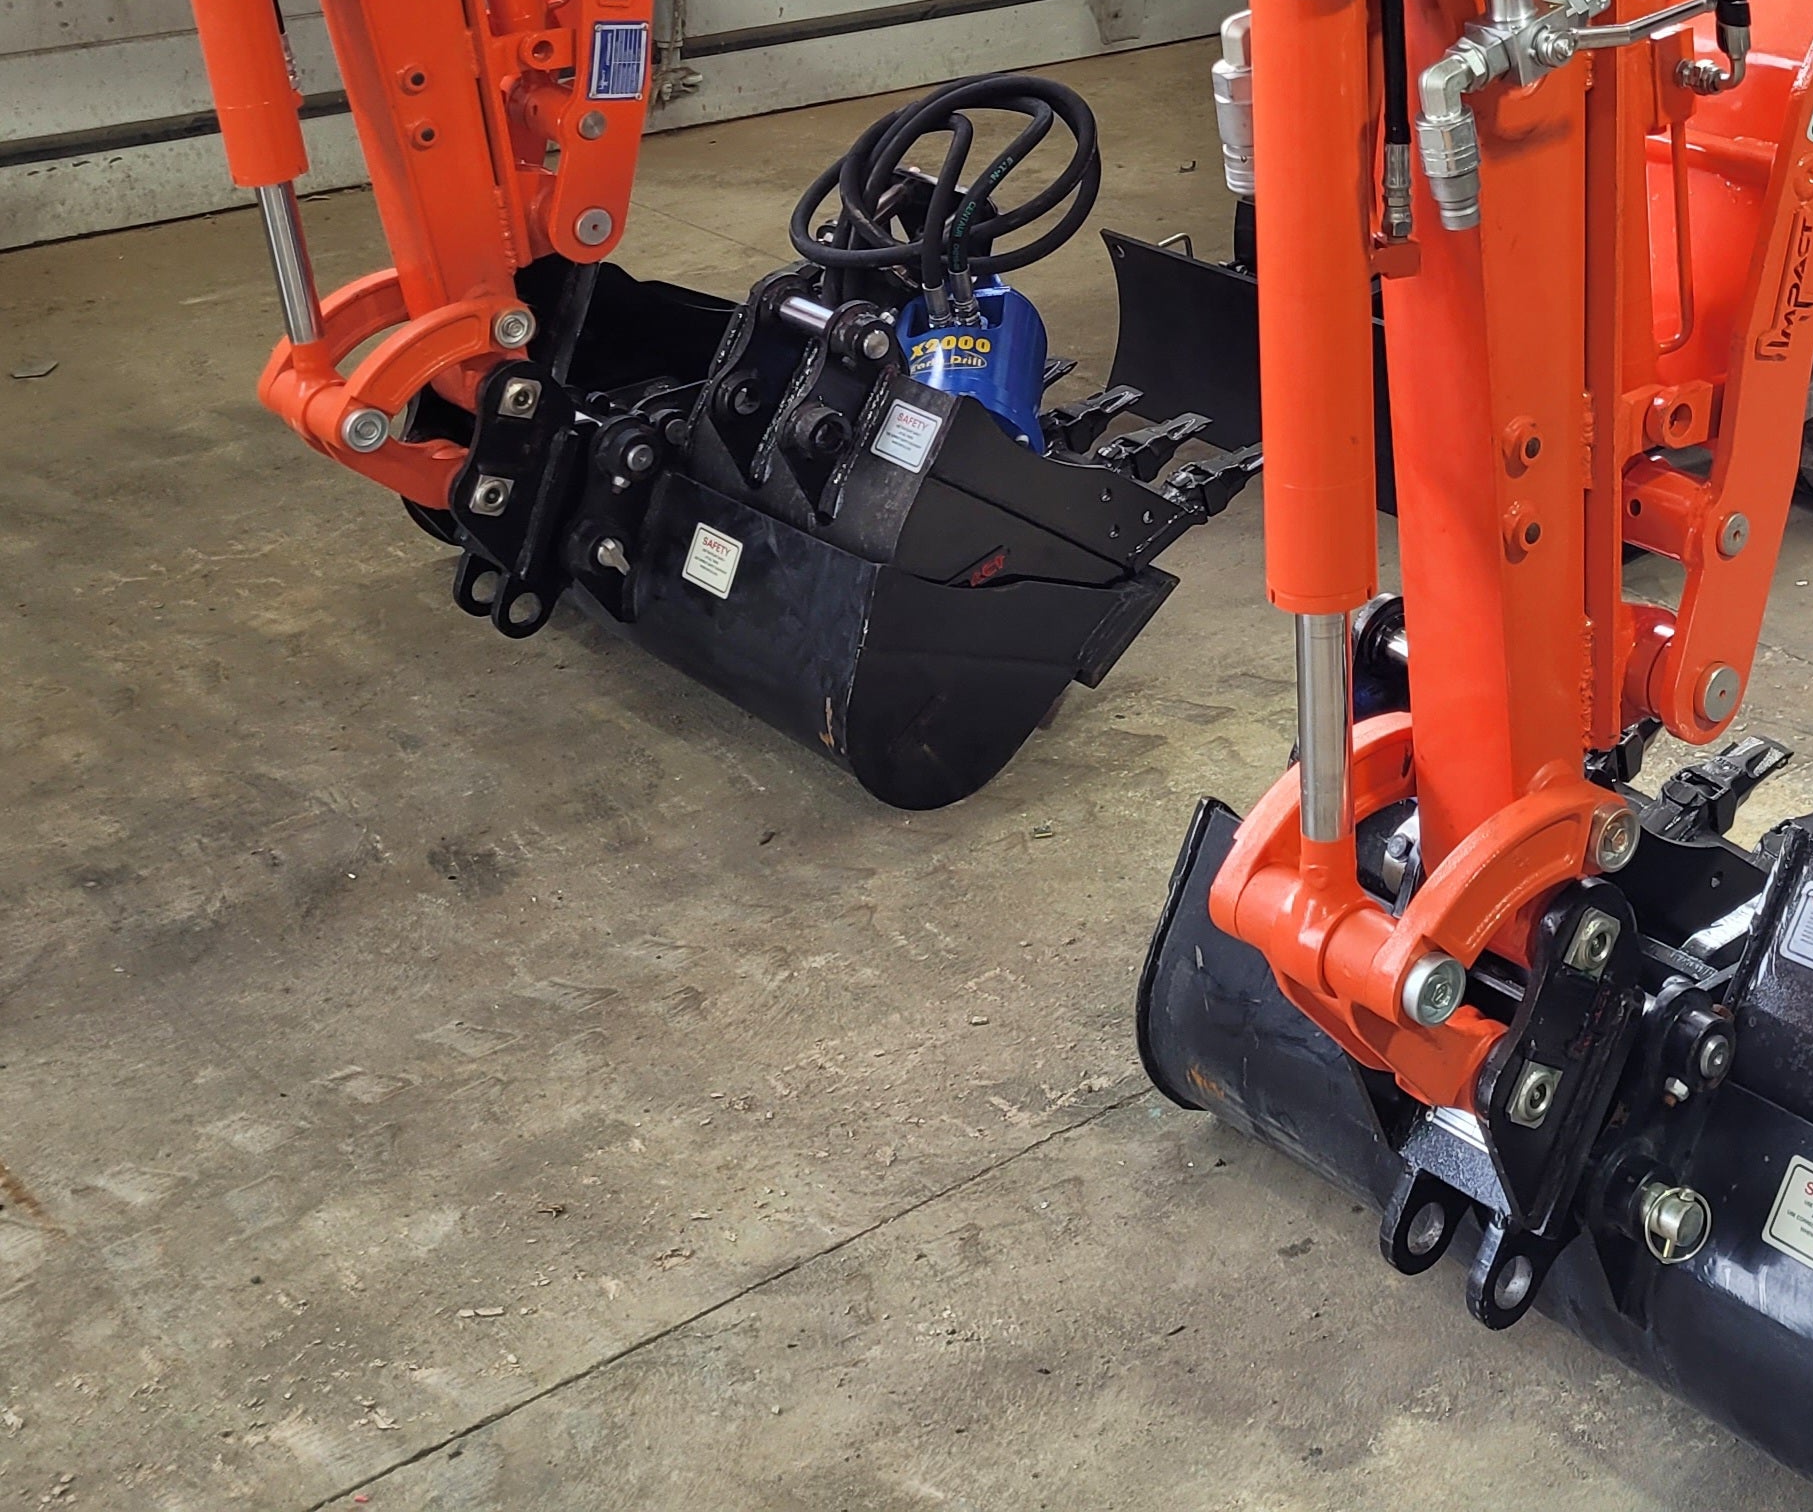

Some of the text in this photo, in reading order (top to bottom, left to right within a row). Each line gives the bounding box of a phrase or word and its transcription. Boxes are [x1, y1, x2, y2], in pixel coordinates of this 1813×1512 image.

[911, 335, 992, 360] X2000
[950, 354, 982, 368] Drill
[896, 413, 929, 431] SAFETY
[702, 537, 731, 557] SAFETY
